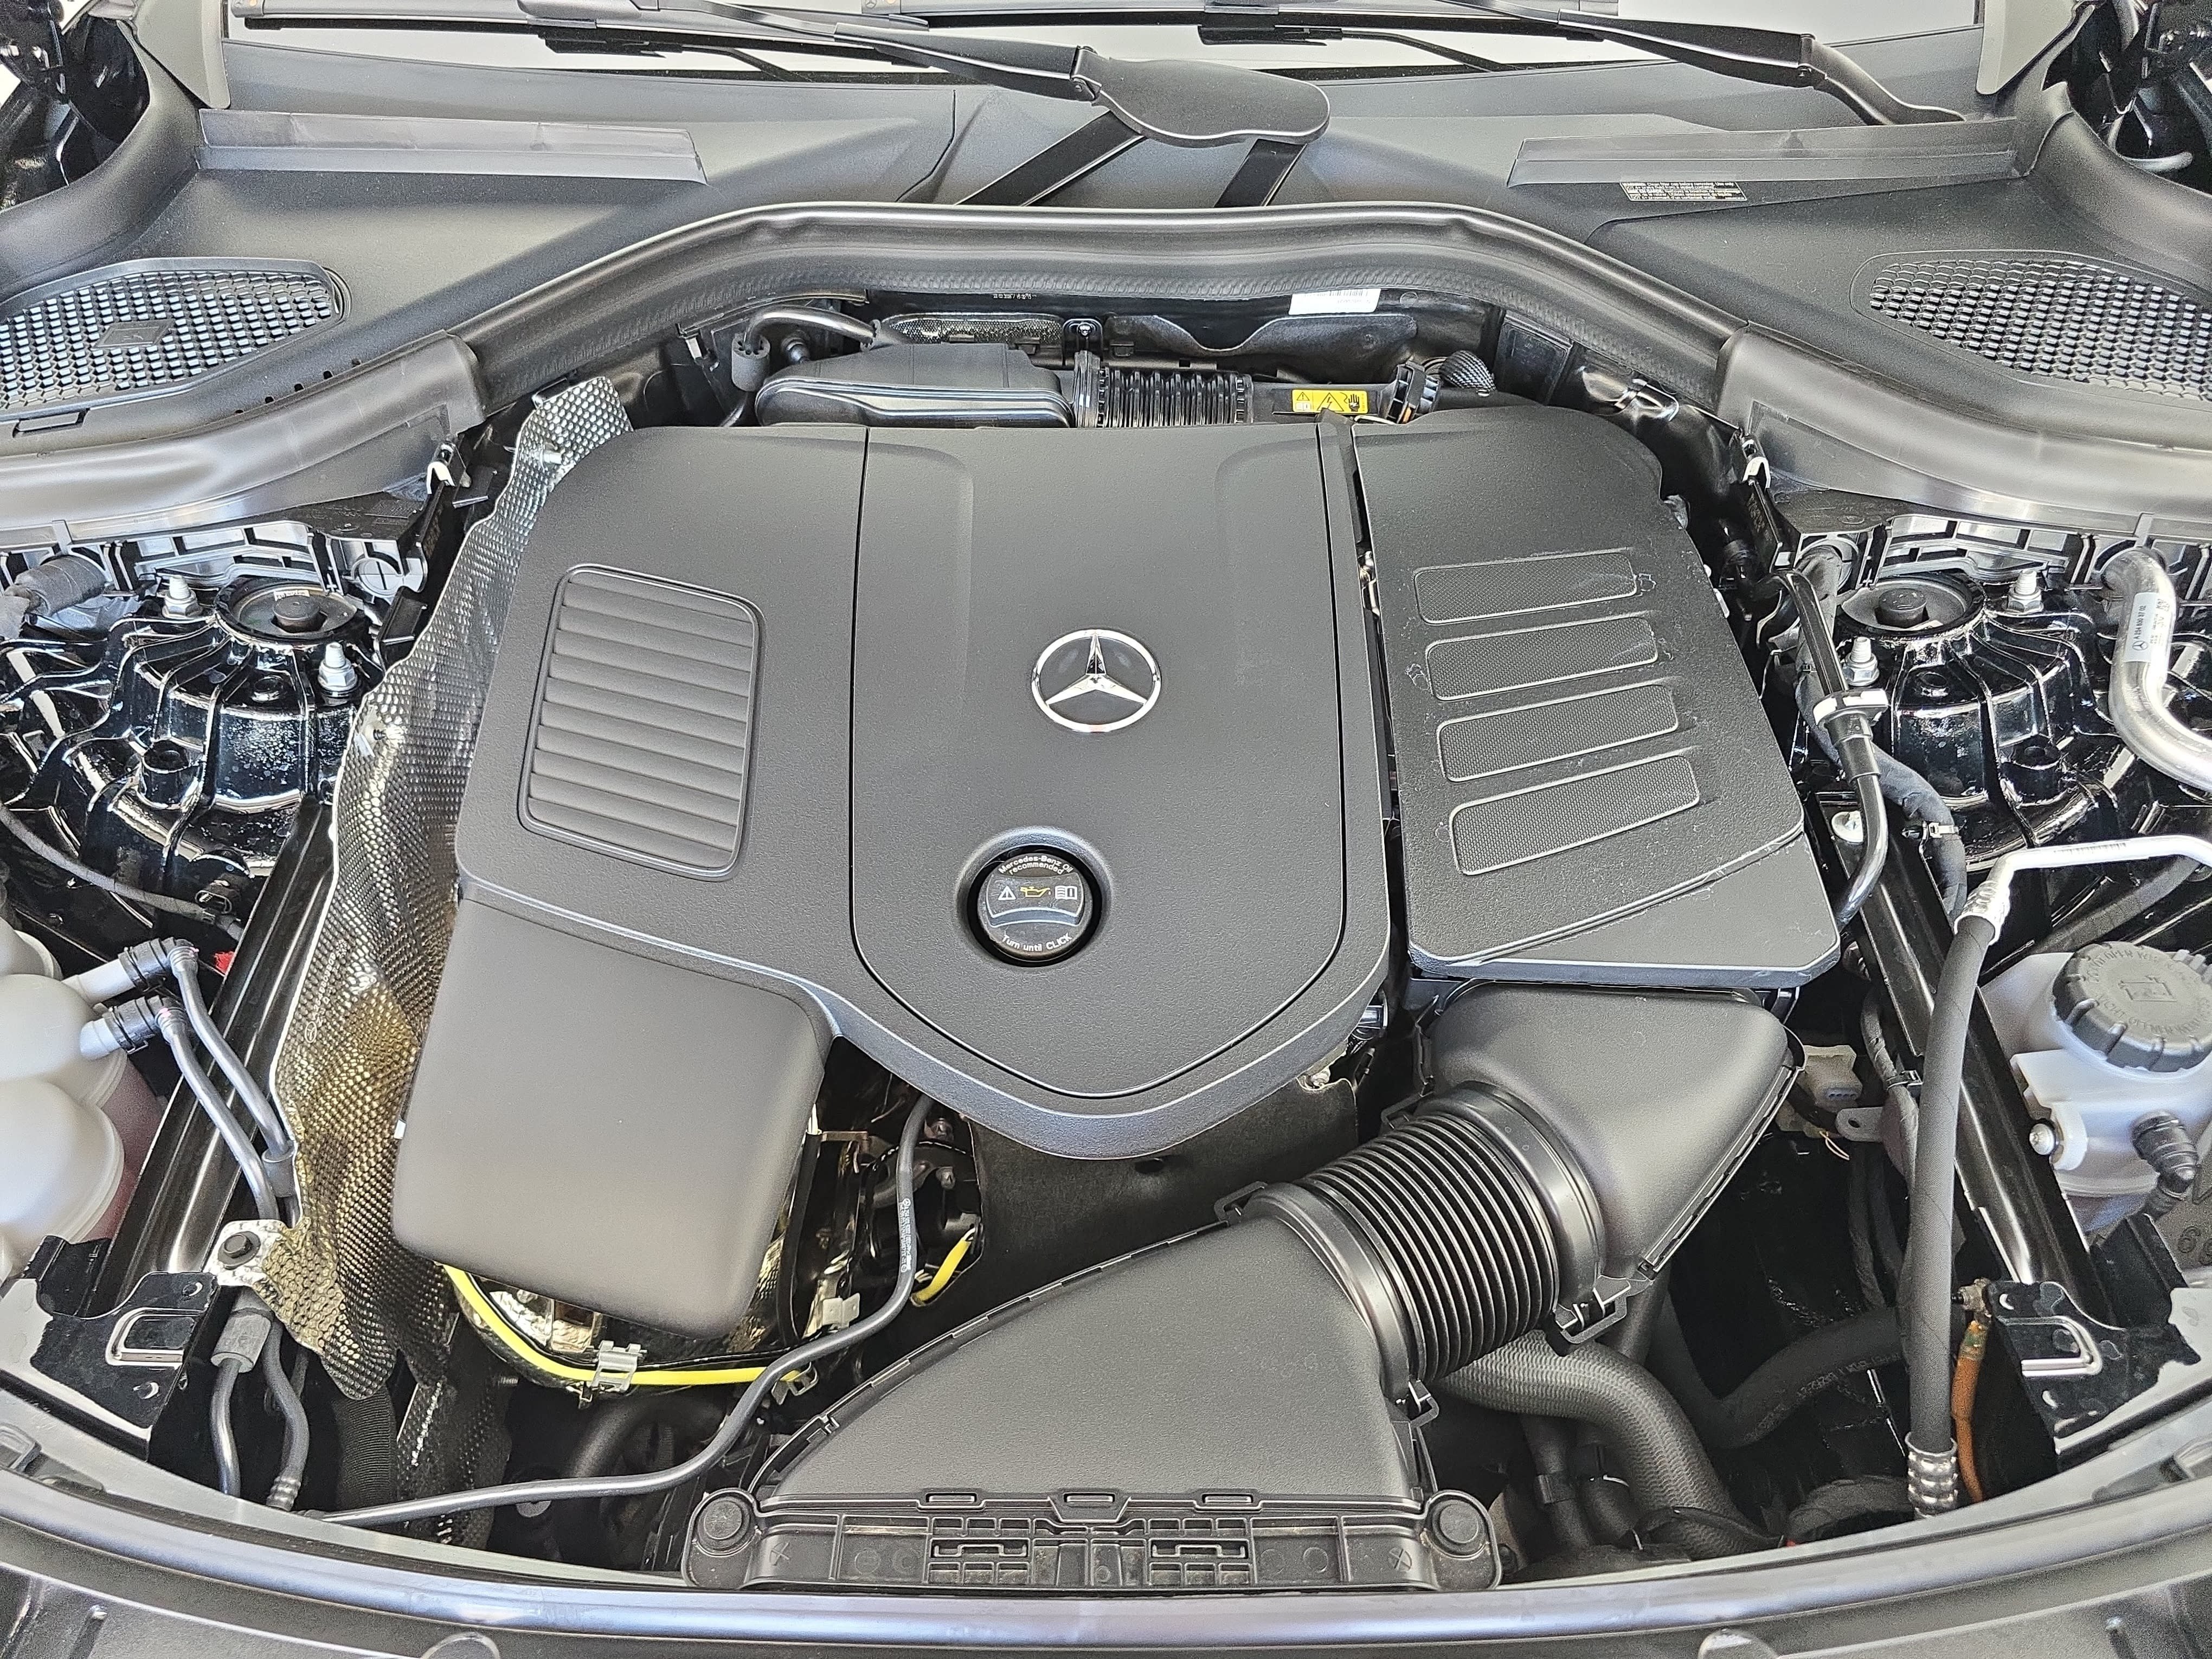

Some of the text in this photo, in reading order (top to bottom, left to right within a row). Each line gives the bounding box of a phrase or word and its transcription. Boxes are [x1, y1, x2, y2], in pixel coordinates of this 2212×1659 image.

[998, 855, 1073, 873] Mercedes-Benz Oil
[1009, 862, 1064, 875] recommended
[1002, 933, 1072, 951] Turn until CLICK
